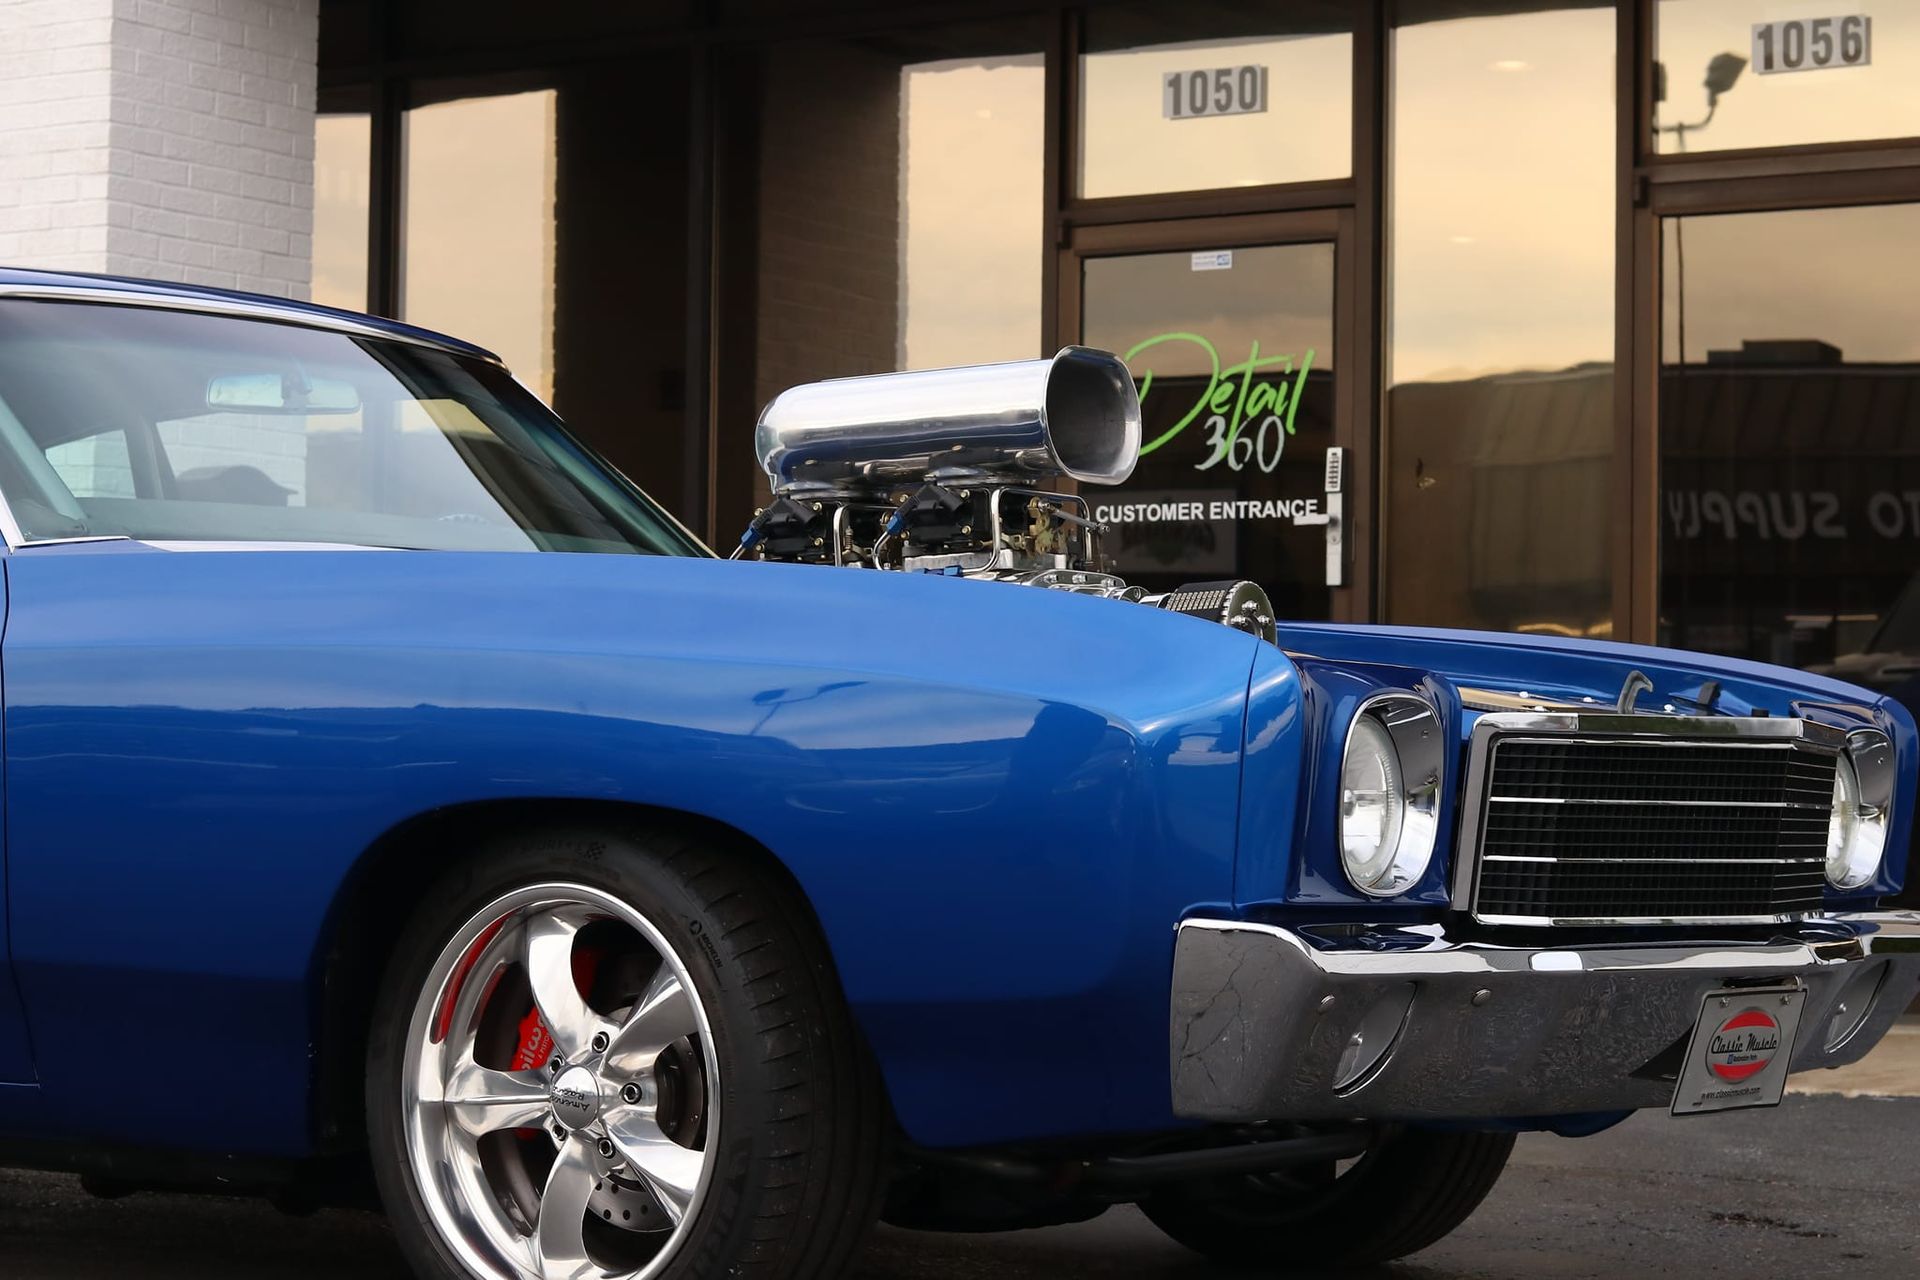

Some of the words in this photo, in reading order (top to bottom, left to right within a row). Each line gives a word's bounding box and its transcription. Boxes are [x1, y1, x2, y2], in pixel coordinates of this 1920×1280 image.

[1757, 15, 1862, 71] 1056
[1167, 65, 1258, 116] 1050
[1124, 332, 1315, 460] Detail
[1194, 415, 1285, 473] 360
[1095, 502, 1204, 523] CUSTOMER
[1209, 499, 1318, 520] ENTRANCE
[1711, 1034, 1743, 1054] Classic
[1745, 1033, 1777, 1052] Muscle
